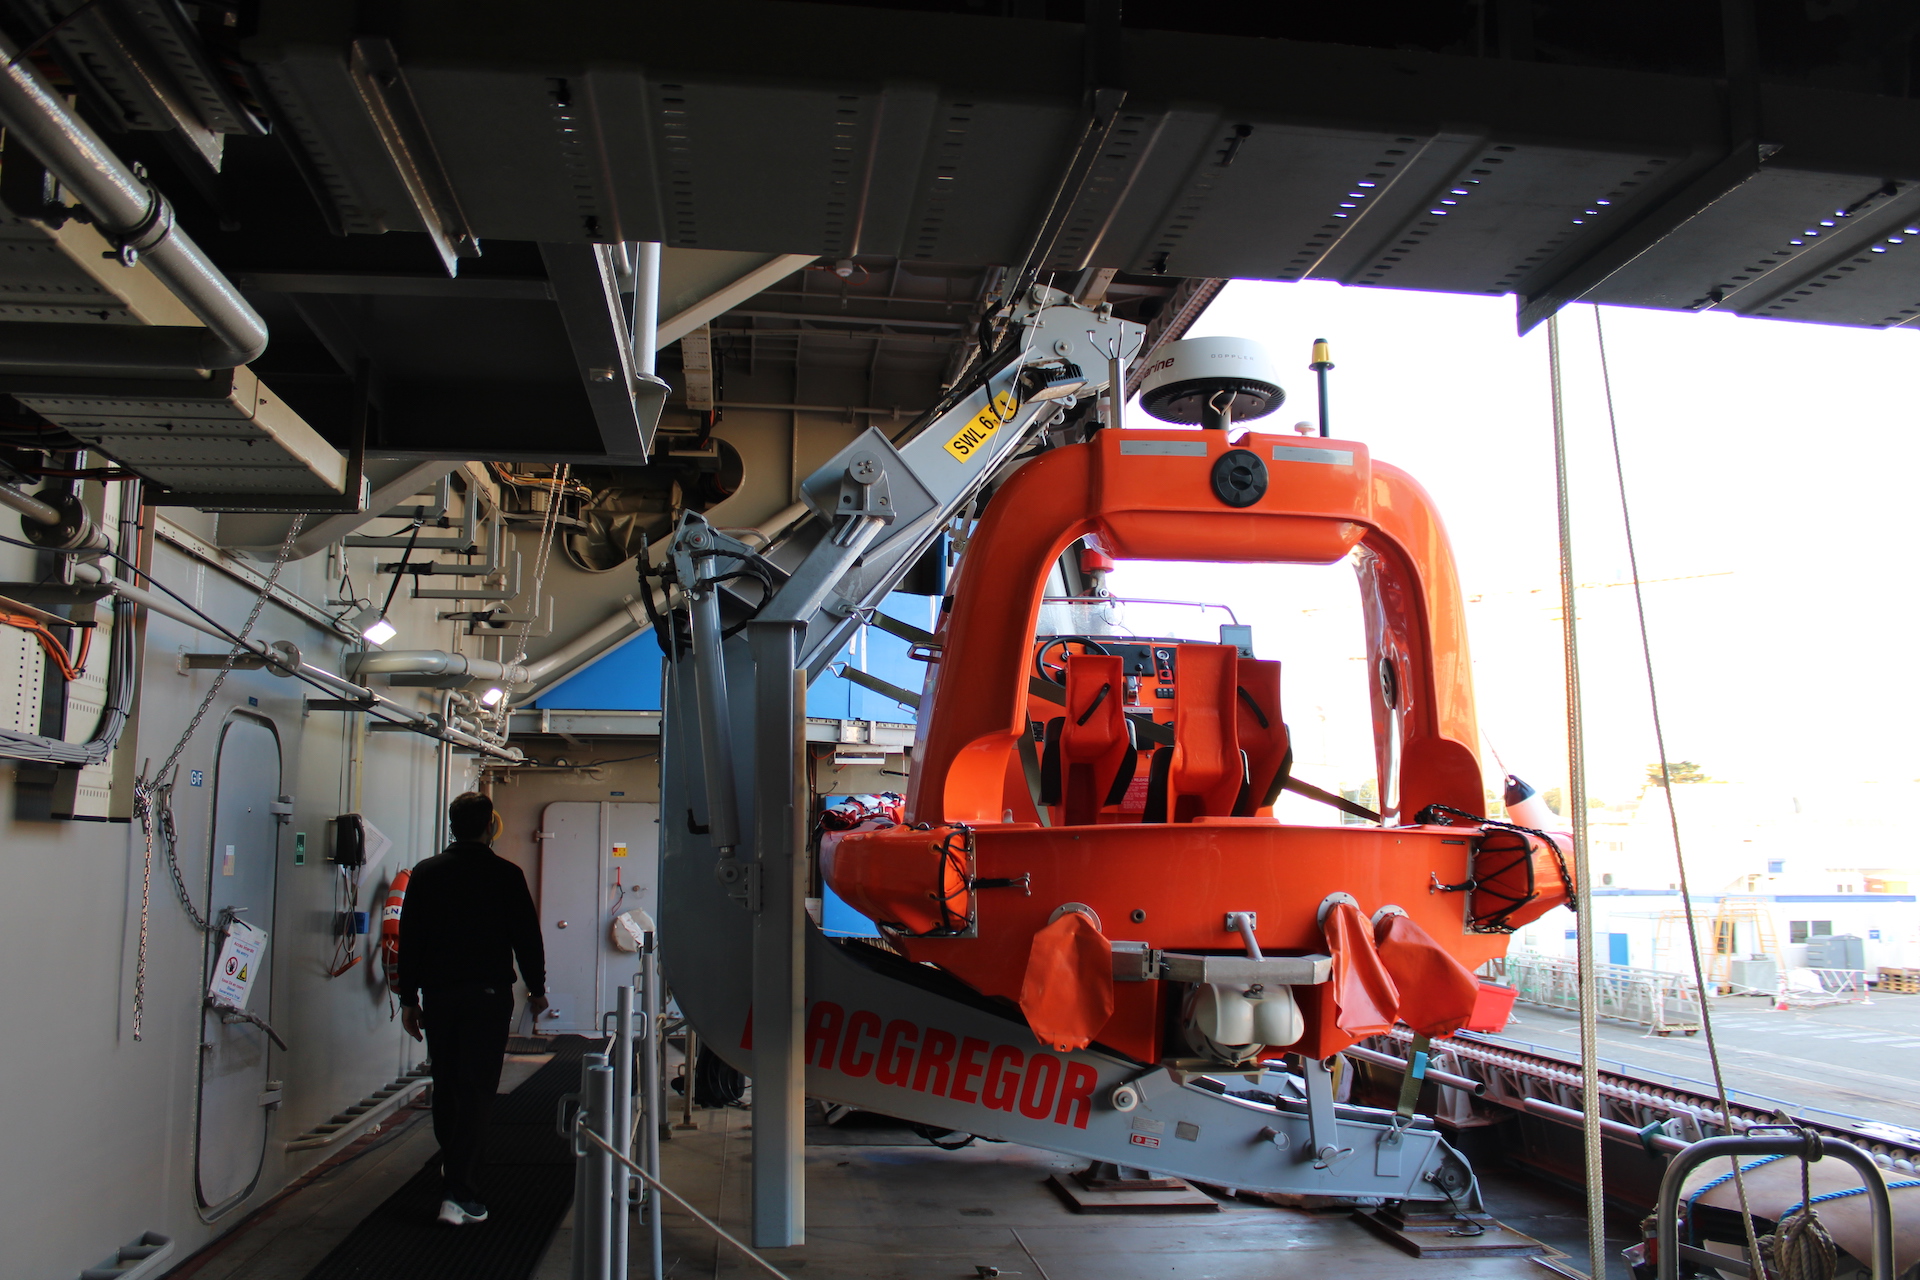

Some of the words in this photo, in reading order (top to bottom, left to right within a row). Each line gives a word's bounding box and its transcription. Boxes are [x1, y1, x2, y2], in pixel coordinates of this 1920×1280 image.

[1144, 358, 1174, 378] arine
[1211, 353, 1254, 361] DOPPLER
[953, 427, 987, 455] SWL
[1000, 399, 1014, 412] t
[740, 998, 1098, 1130] ACGREGOR
